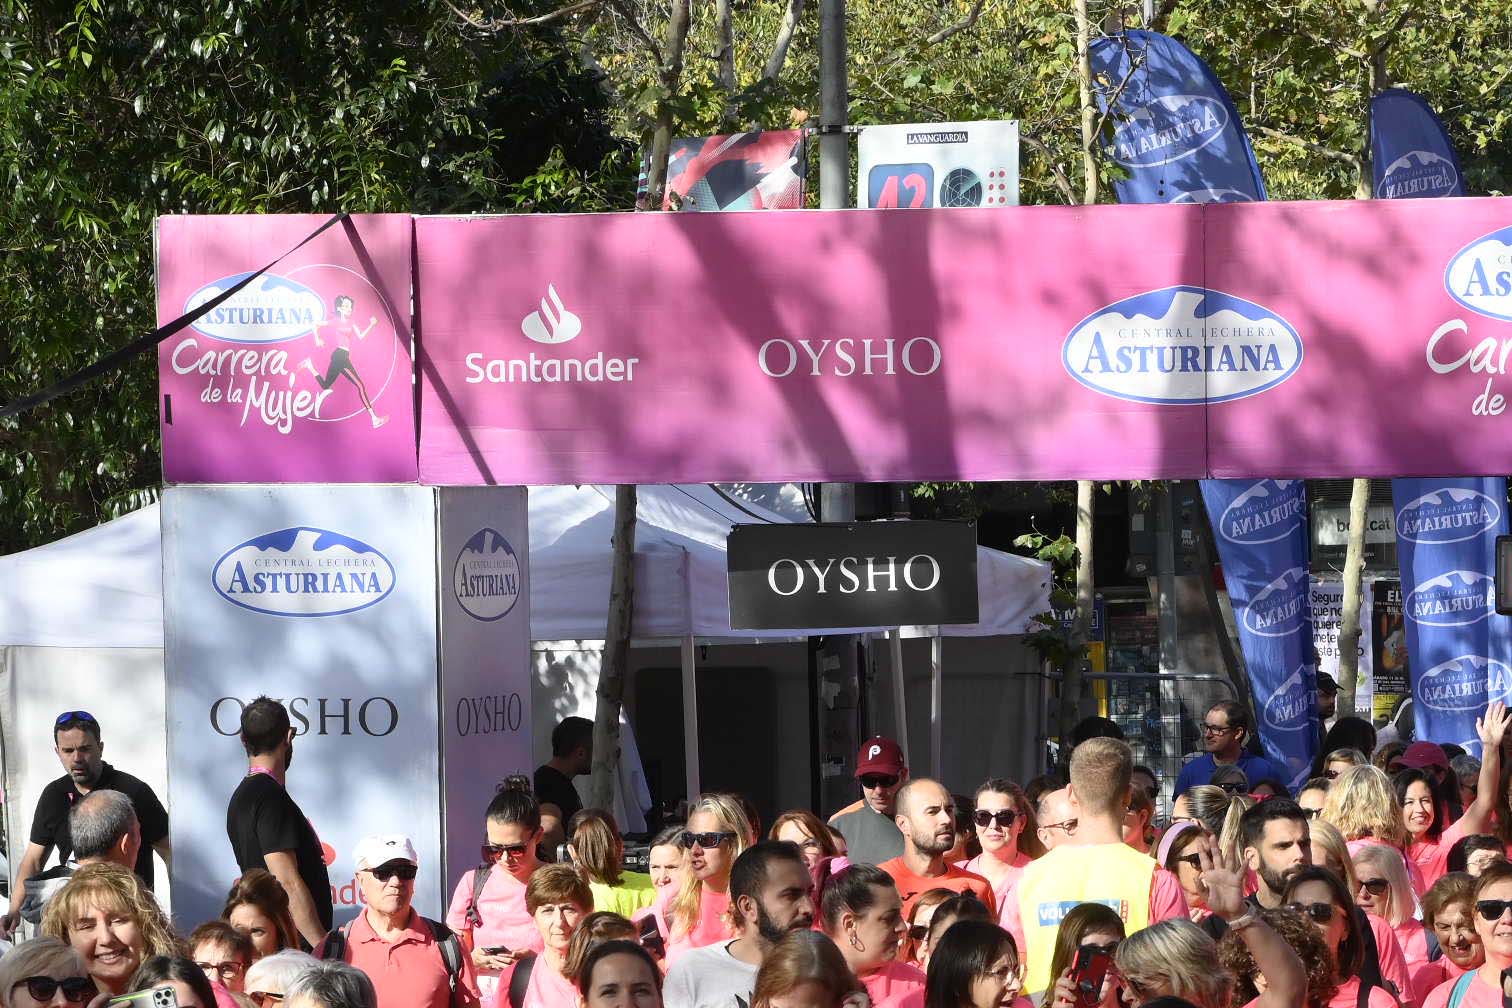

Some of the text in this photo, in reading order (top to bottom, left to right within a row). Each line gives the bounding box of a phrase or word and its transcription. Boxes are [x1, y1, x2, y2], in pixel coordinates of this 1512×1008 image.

[916, 132, 967, 143] VANGUARDIA
[1118, 327, 1276, 339] CENTRAL LECHERA
[171, 338, 289, 376] Carrera
[465, 351, 640, 384] Santander
[758, 336, 942, 378] OYSHO
[1082, 331, 1285, 374] ASTURIANA
[200, 371, 334, 435] de la Mujer
[1472, 377, 1506, 416] de
[227, 560, 382, 594] ASTURIANA
[254, 558, 376, 568] CENTRAL LECHERA
[768, 554, 940, 596] OYSHO
[459, 570, 517, 598] ASTURIANA
[1311, 591, 1344, 605] Segur
[1312, 606, 1329, 618] que
[1312, 617, 1345, 631] quiere
[210, 696, 398, 736] OSHO
[456, 693, 522, 736] OYSHO
